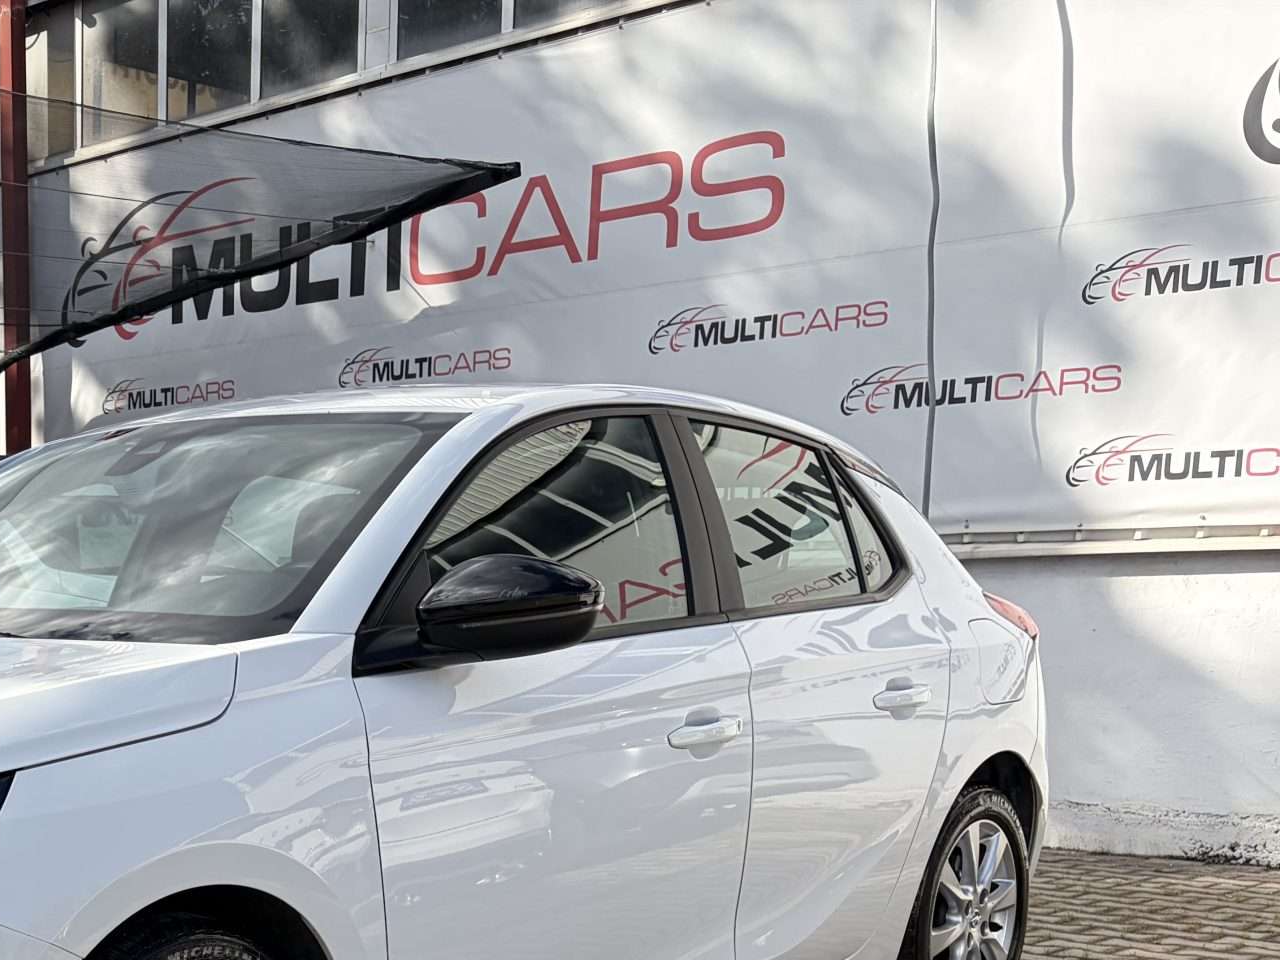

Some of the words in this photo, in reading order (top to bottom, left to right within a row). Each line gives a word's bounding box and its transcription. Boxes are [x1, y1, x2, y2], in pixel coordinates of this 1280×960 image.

[171, 130, 785, 324] MULTICARS
[693, 300, 889, 348] MULTICARS
[371, 347, 512, 384] MULTICARS
[893, 364, 1122, 410] MULTICARS
[127, 379, 235, 411] MULTICARS
